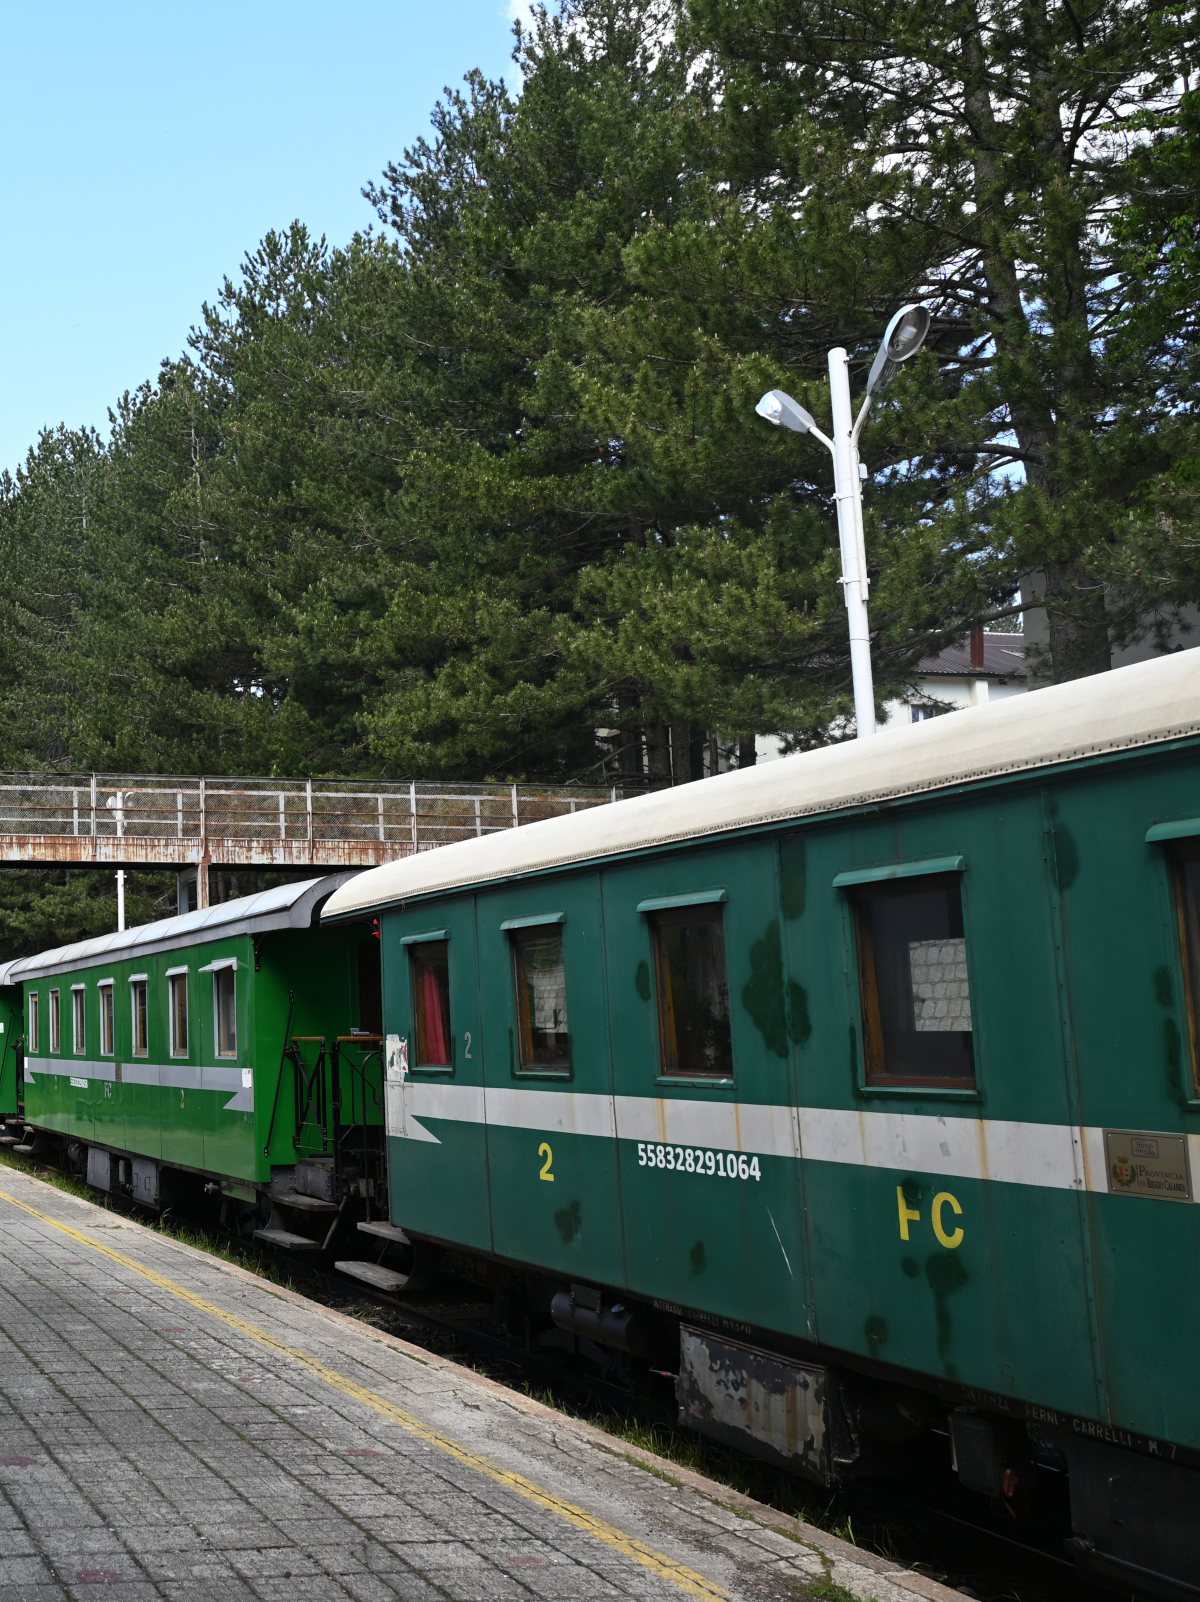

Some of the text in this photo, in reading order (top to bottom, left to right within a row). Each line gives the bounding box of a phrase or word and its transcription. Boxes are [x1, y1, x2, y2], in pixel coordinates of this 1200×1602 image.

[464, 1032, 472, 1059] 2
[104, 1082, 112, 1099] FC
[180, 1089, 185, 1108] 2
[1135, 1140, 1154, 1149] Treno
[1144, 1148, 1156, 1157] Sila
[538, 1142, 555, 1182] 2
[637, 1143, 762, 1181] 558328291064
[1073, 1418, 1132, 1447] CARRELLI
